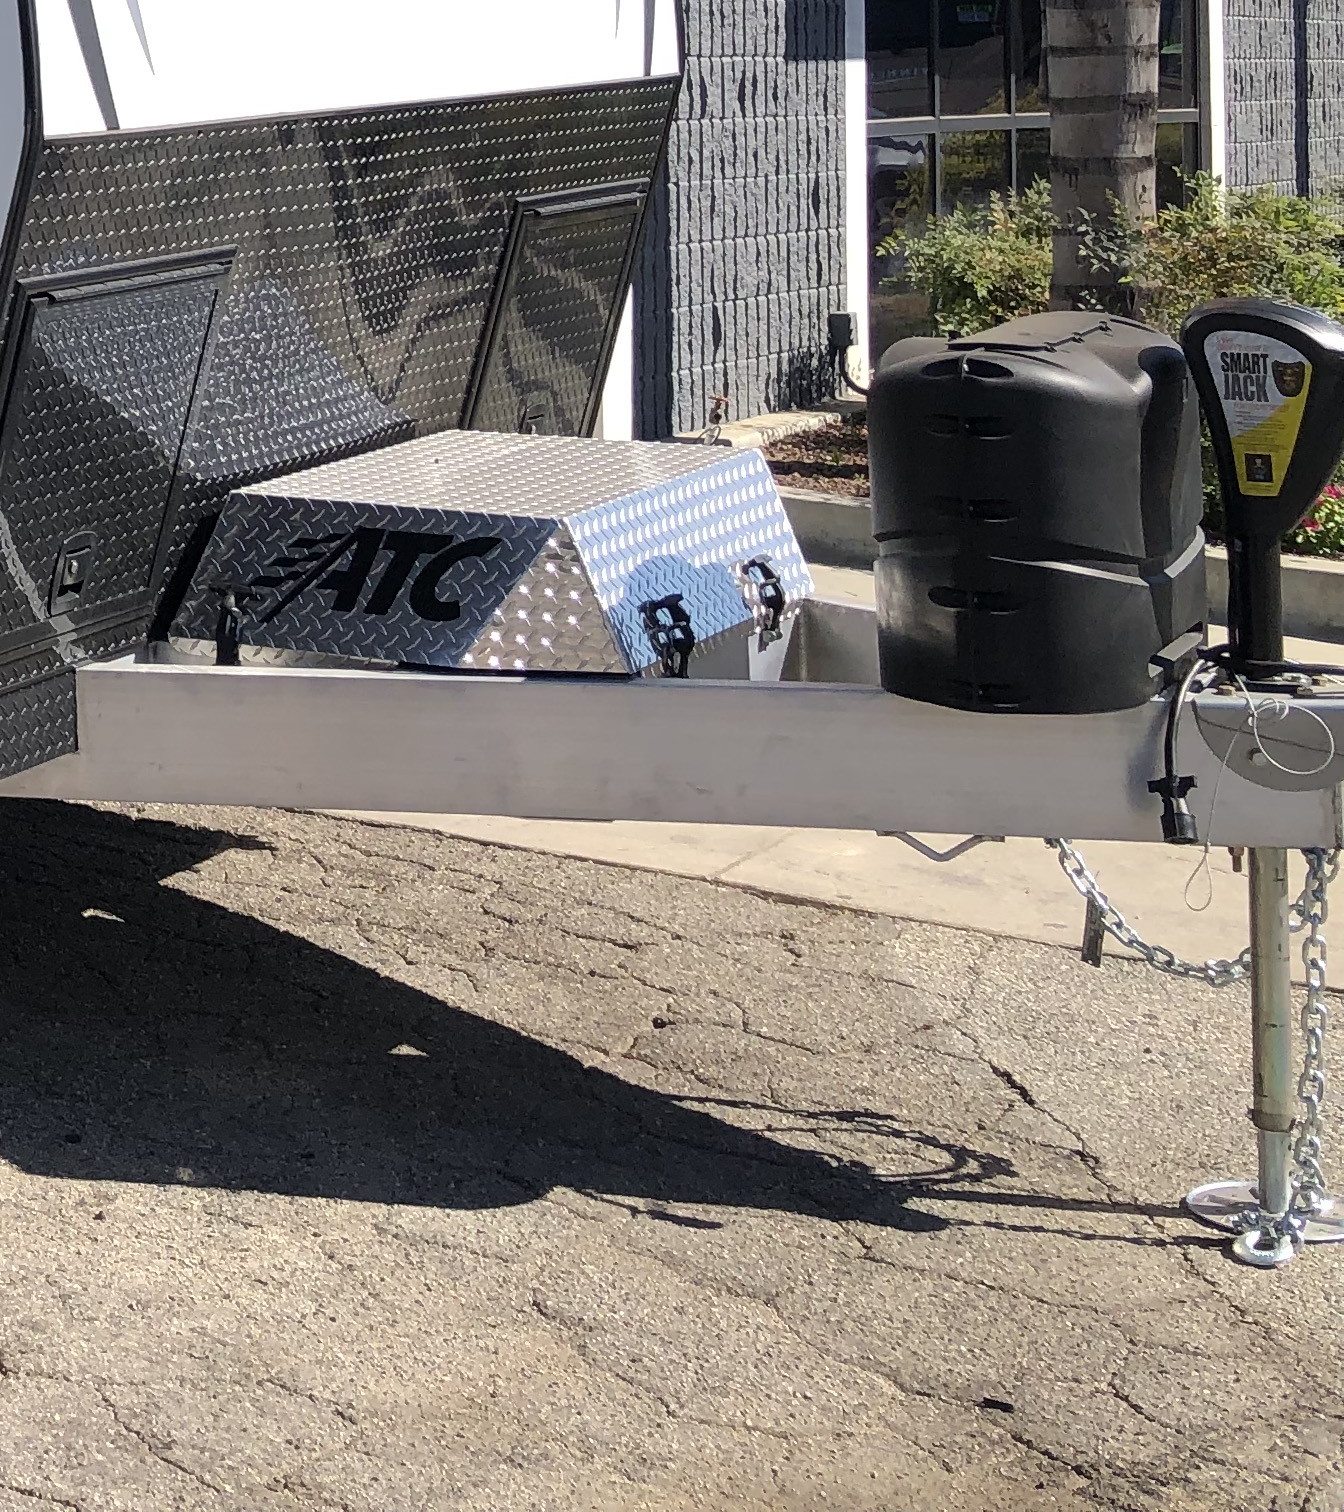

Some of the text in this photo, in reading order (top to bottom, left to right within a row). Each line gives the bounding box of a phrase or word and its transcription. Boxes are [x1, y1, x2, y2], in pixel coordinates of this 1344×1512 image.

[1220, 350, 1269, 375] SMART
[1223, 372, 1270, 403] JACK
[260, 526, 502, 623] ATC
